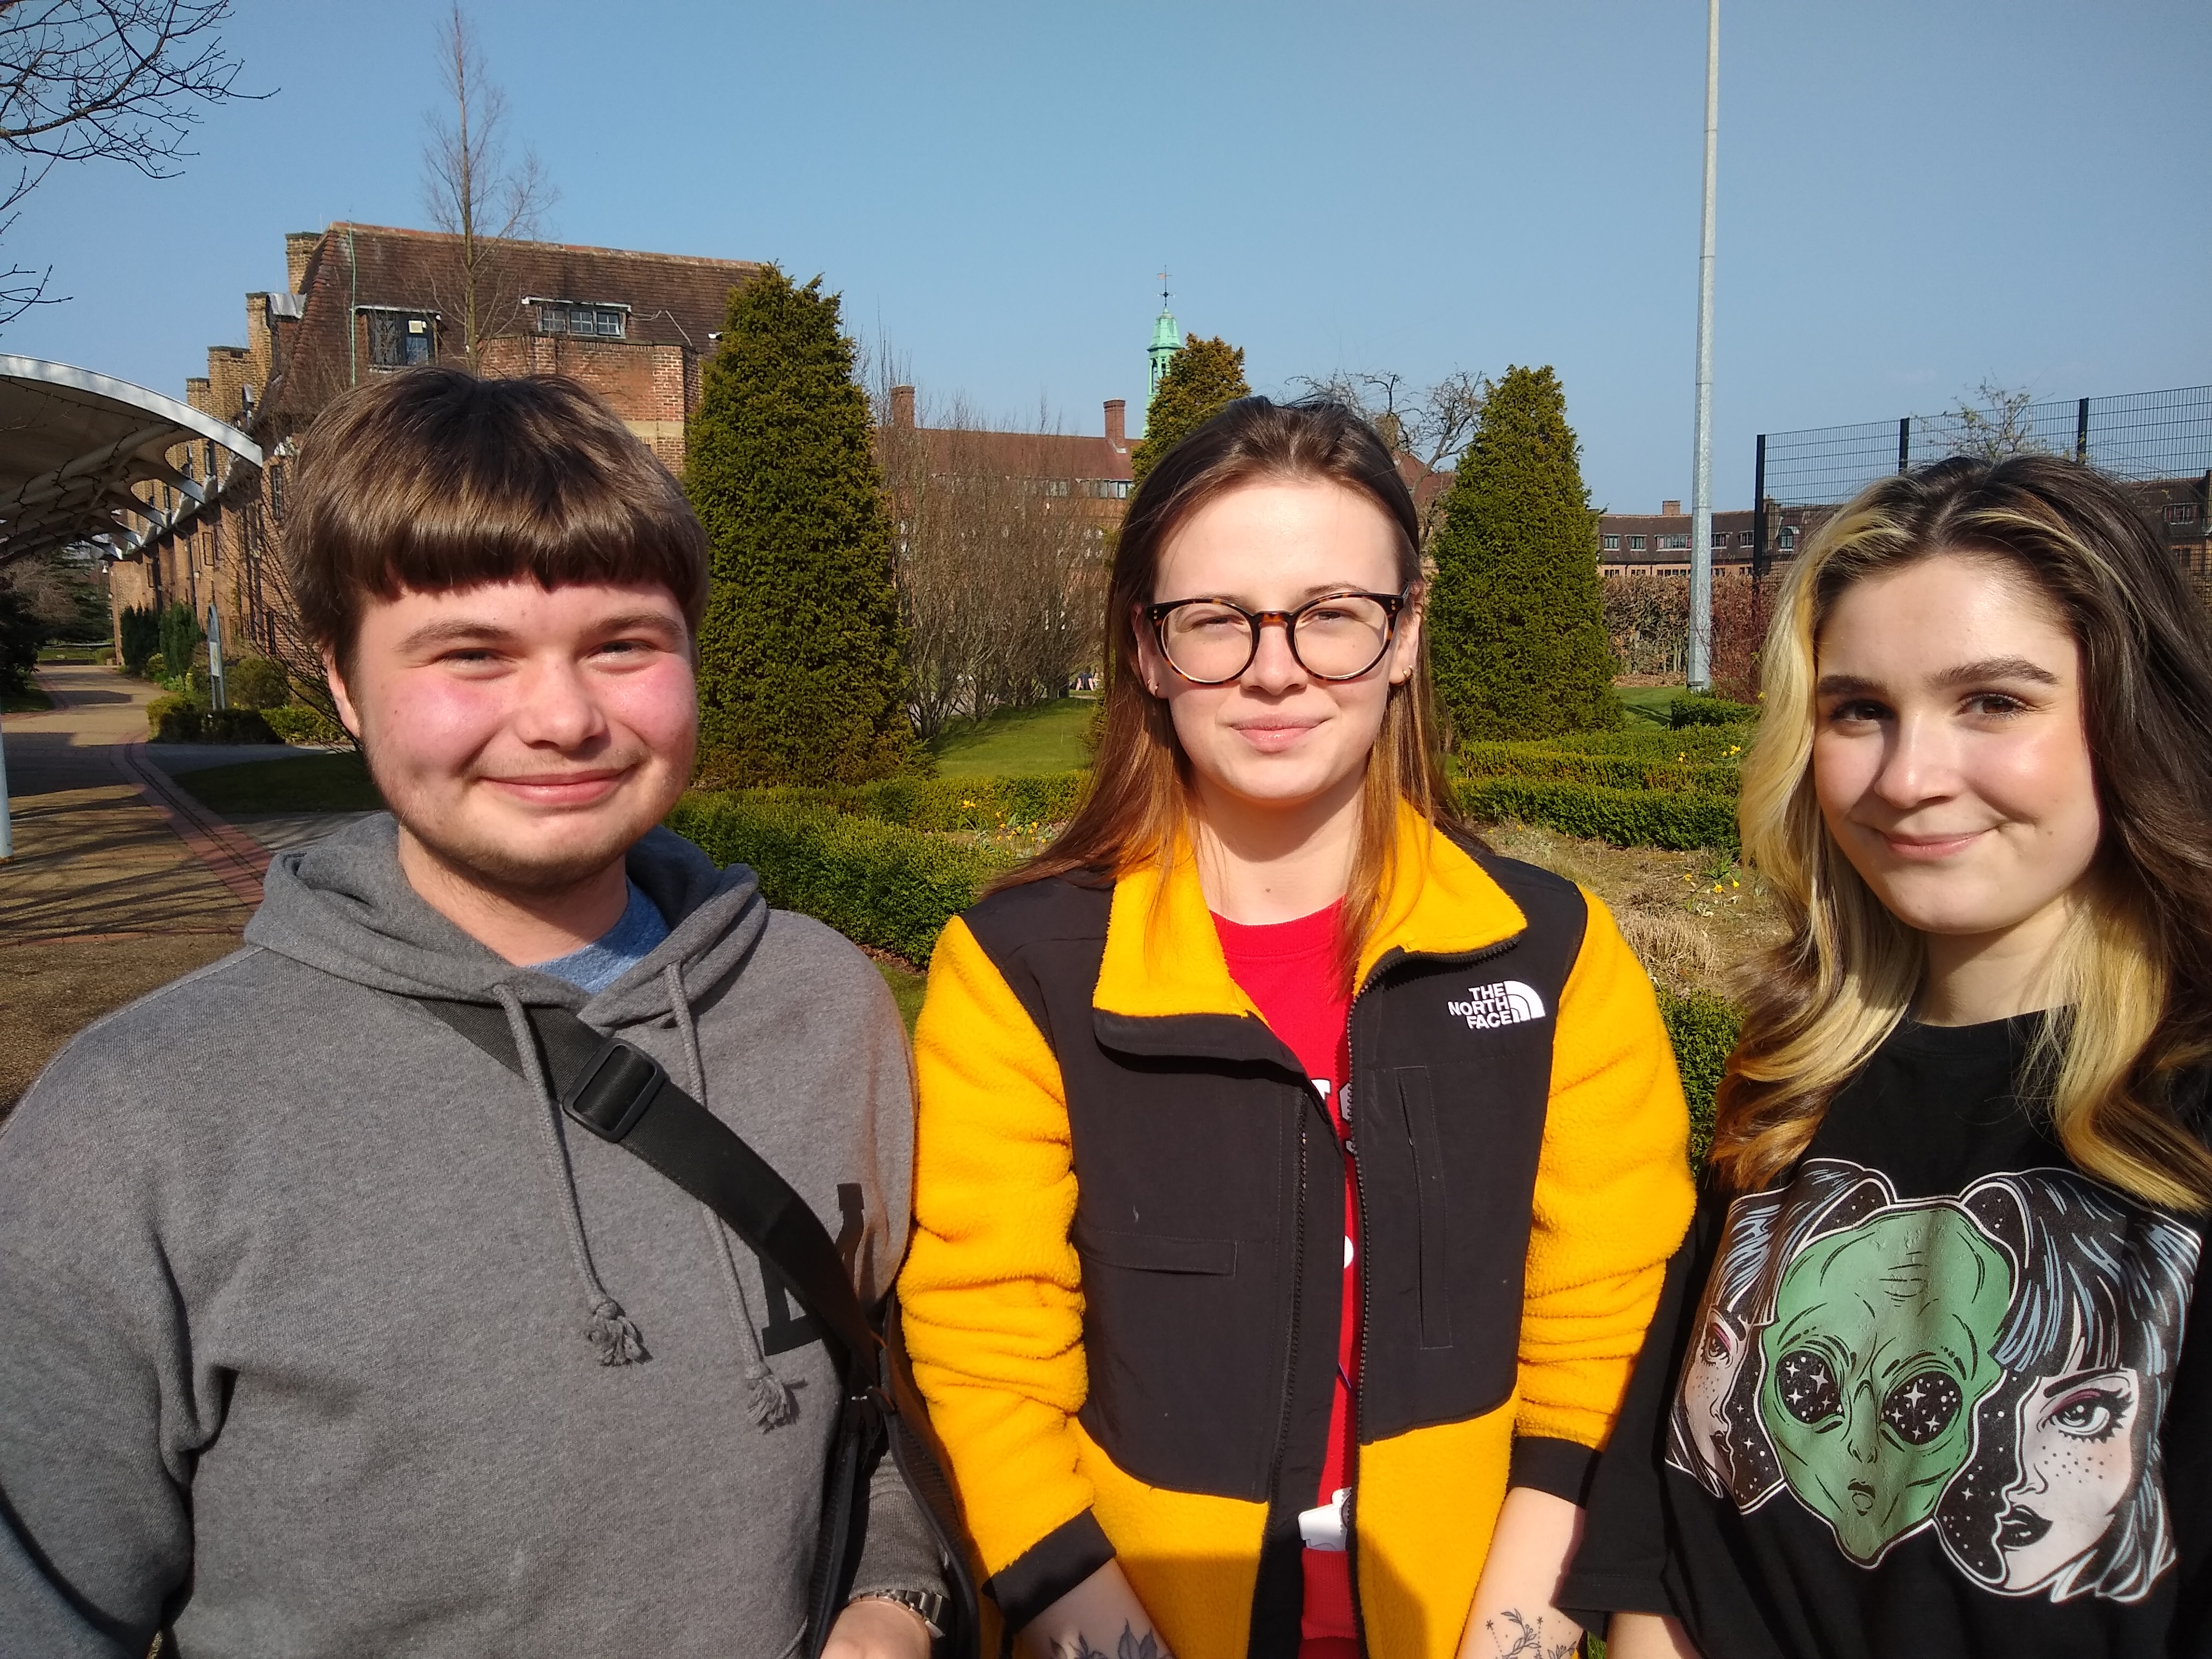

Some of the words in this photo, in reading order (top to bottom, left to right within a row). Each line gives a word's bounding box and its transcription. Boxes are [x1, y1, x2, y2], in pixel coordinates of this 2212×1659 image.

[1468, 982, 1506, 1001] THE
[1447, 996, 1509, 1016] NORTH
[1466, 1010, 1512, 1029] FACE
